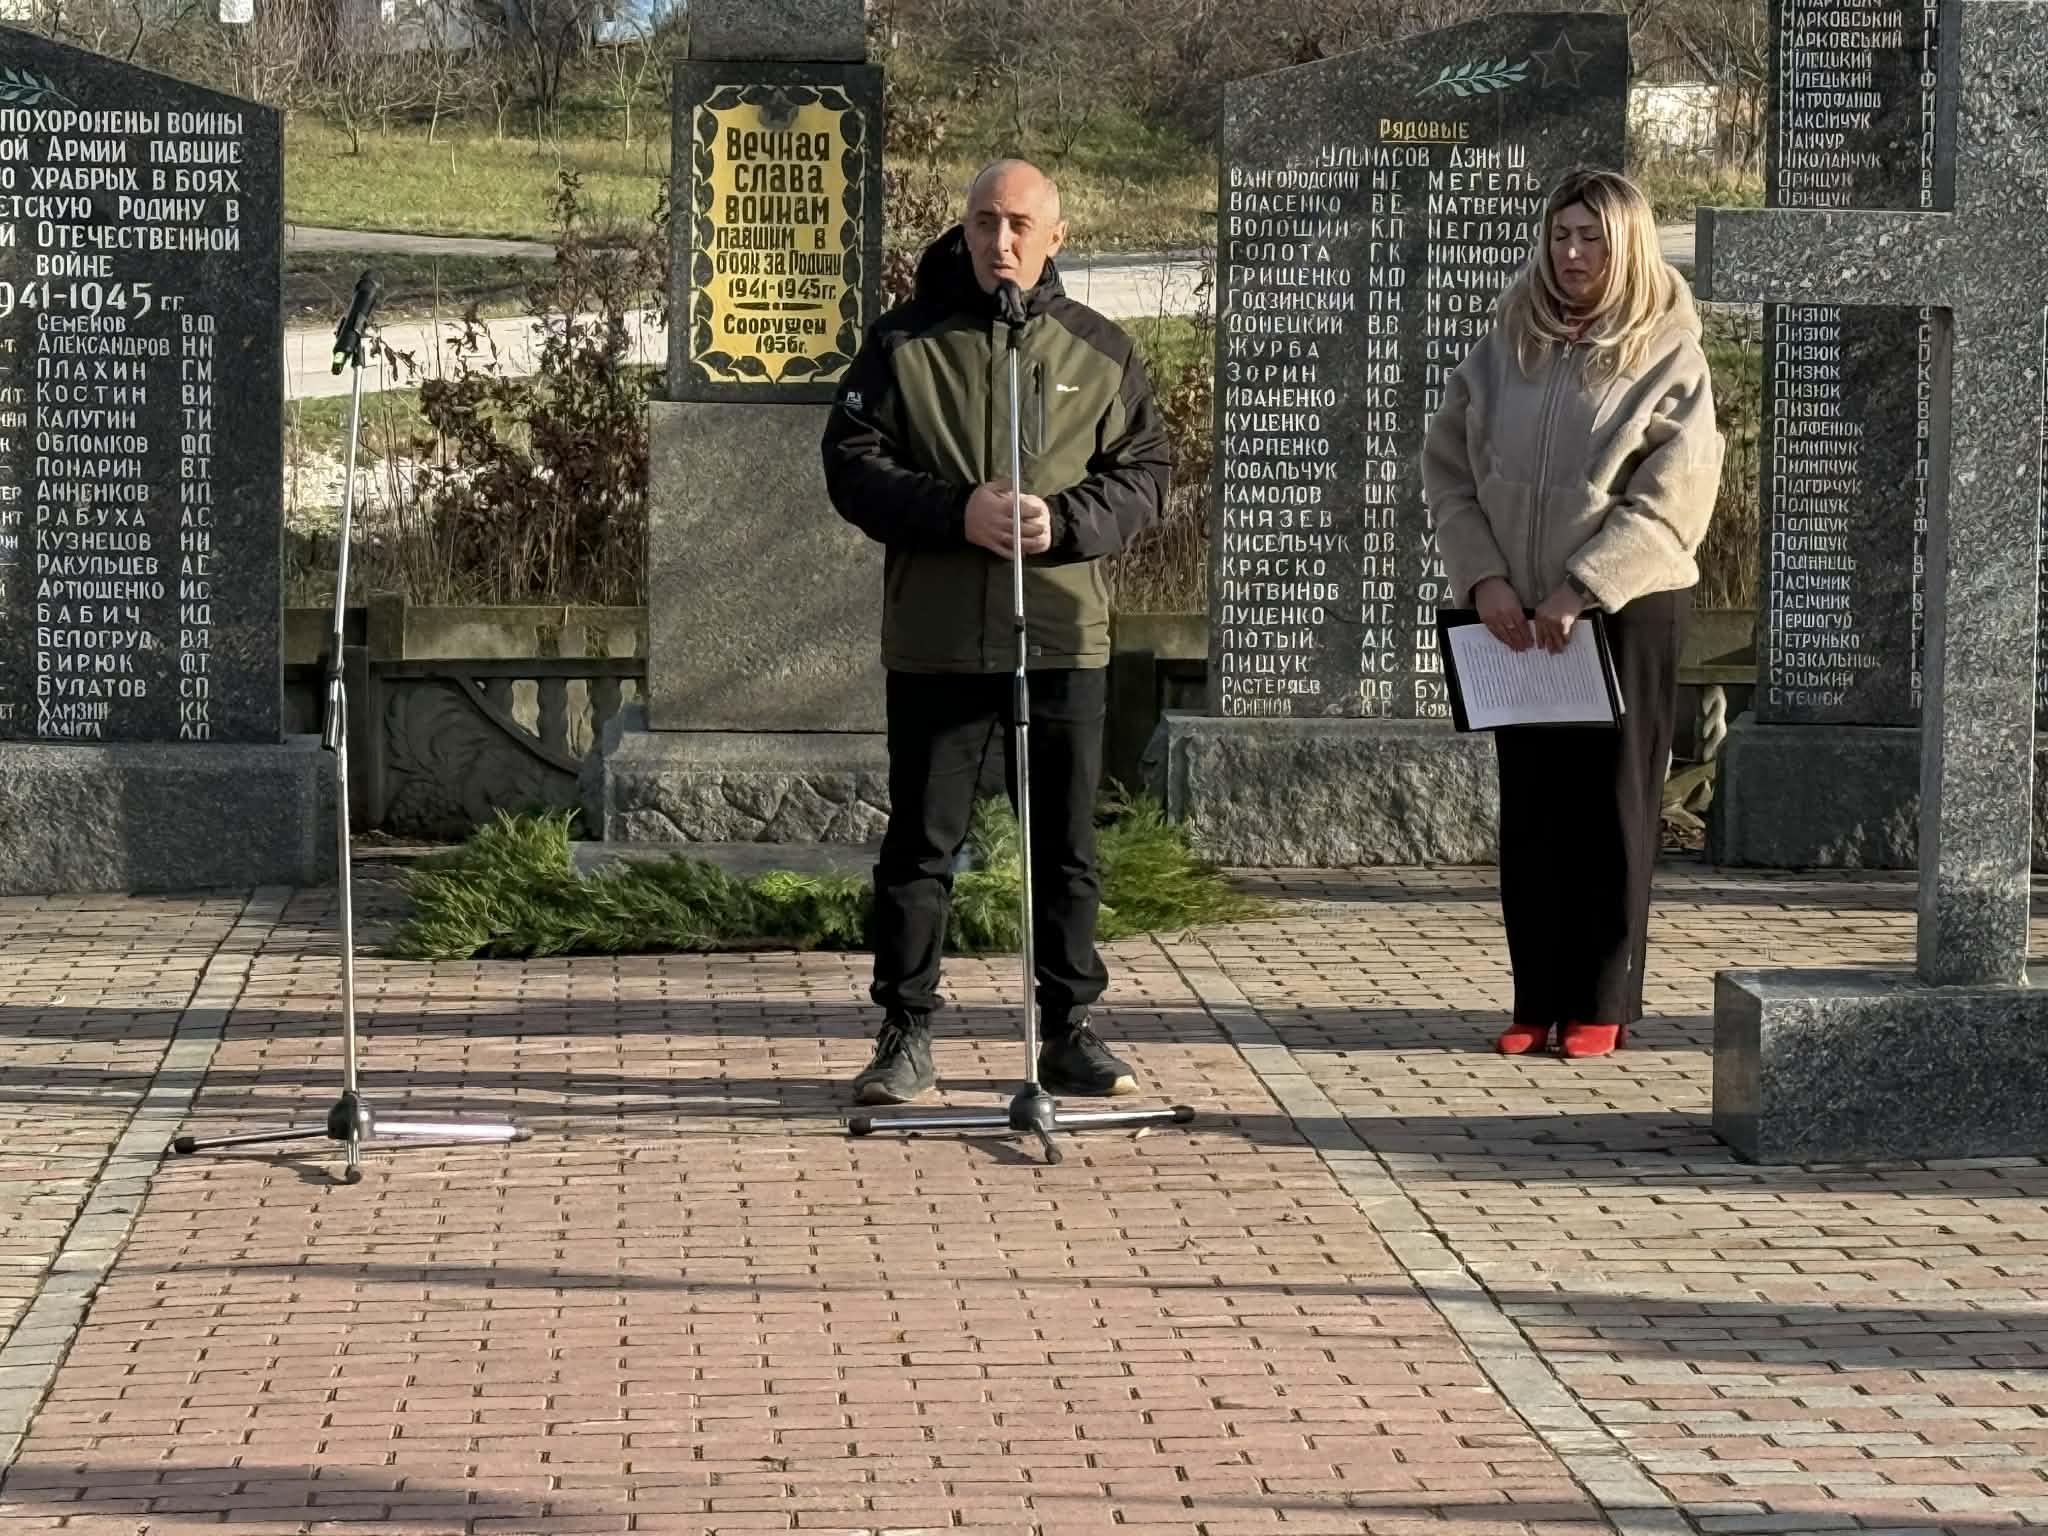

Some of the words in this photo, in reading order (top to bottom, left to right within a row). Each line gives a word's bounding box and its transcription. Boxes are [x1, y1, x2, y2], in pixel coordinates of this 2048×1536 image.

[0, 108, 160, 134] ПОХОРОНЕНЫ
[167, 111, 243, 135] ВОИНЫ
[1379, 118, 1471, 141] РЯДОВЫЕ
[150, 140, 242, 164] ПАВШИЕ
[726, 126, 830, 161] Вечная
[30, 166, 139, 191] ХРАБРЫХ
[152, 169, 166, 191] В
[175, 169, 241, 193] БОЯХ
[734, 163, 824, 194] слава
[118, 195, 206, 222] РОДИНУ
[226, 199, 240, 223] В
[725, 195, 830, 225] воинам
[1230, 191, 1342, 215] ВЛАСЕНКО
[38, 220, 240, 251] ОТЕЧЕСТВЕННОЙ
[716, 226, 795, 250] павшим
[814, 227, 826, 249] в
[1230, 240, 1331, 263] ГОЛОТА
[36, 250, 114, 278] ВОЙНЕ
[1229, 264, 1351, 287] ГРИЩЕНКО
[38, 332, 170, 357] АЛЕКСАНДРОВ
[1227, 336, 1320, 358] ЖУРБА
[37, 357, 146, 381] ПЛАХИН
[1226, 362, 1316, 383] ЗОРИН
[37, 382, 147, 405] КОСТИН
[1226, 385, 1336, 408] ИВАНЕНКО
[37, 406, 136, 429] КАЛУГИН
[1225, 411, 1321, 432] КУЦЕНКО
[1225, 434, 1330, 457] КАРПЕНКО
[36, 456, 142, 478] ПОНАРИН
[1224, 459, 1338, 481] КОВАЛЬЧУК
[1224, 483, 1322, 504] КАМОЛОВ
[36, 504, 147, 526] РАБУХА
[1223, 507, 1333, 529] КНЯЗЕВ
[36, 529, 151, 552] КУЗНЕЦОВ
[1223, 530, 1351, 553] КИСЕЛЬЧУК
[1222, 555, 1327, 578] КРЯСКО
[37, 577, 165, 600] АРТЮШЕНКО
[37, 602, 141, 625] БАБИЧ
[37, 650, 134, 673] БИРЮК
[37, 674, 147, 698] БУЛАТОВ
